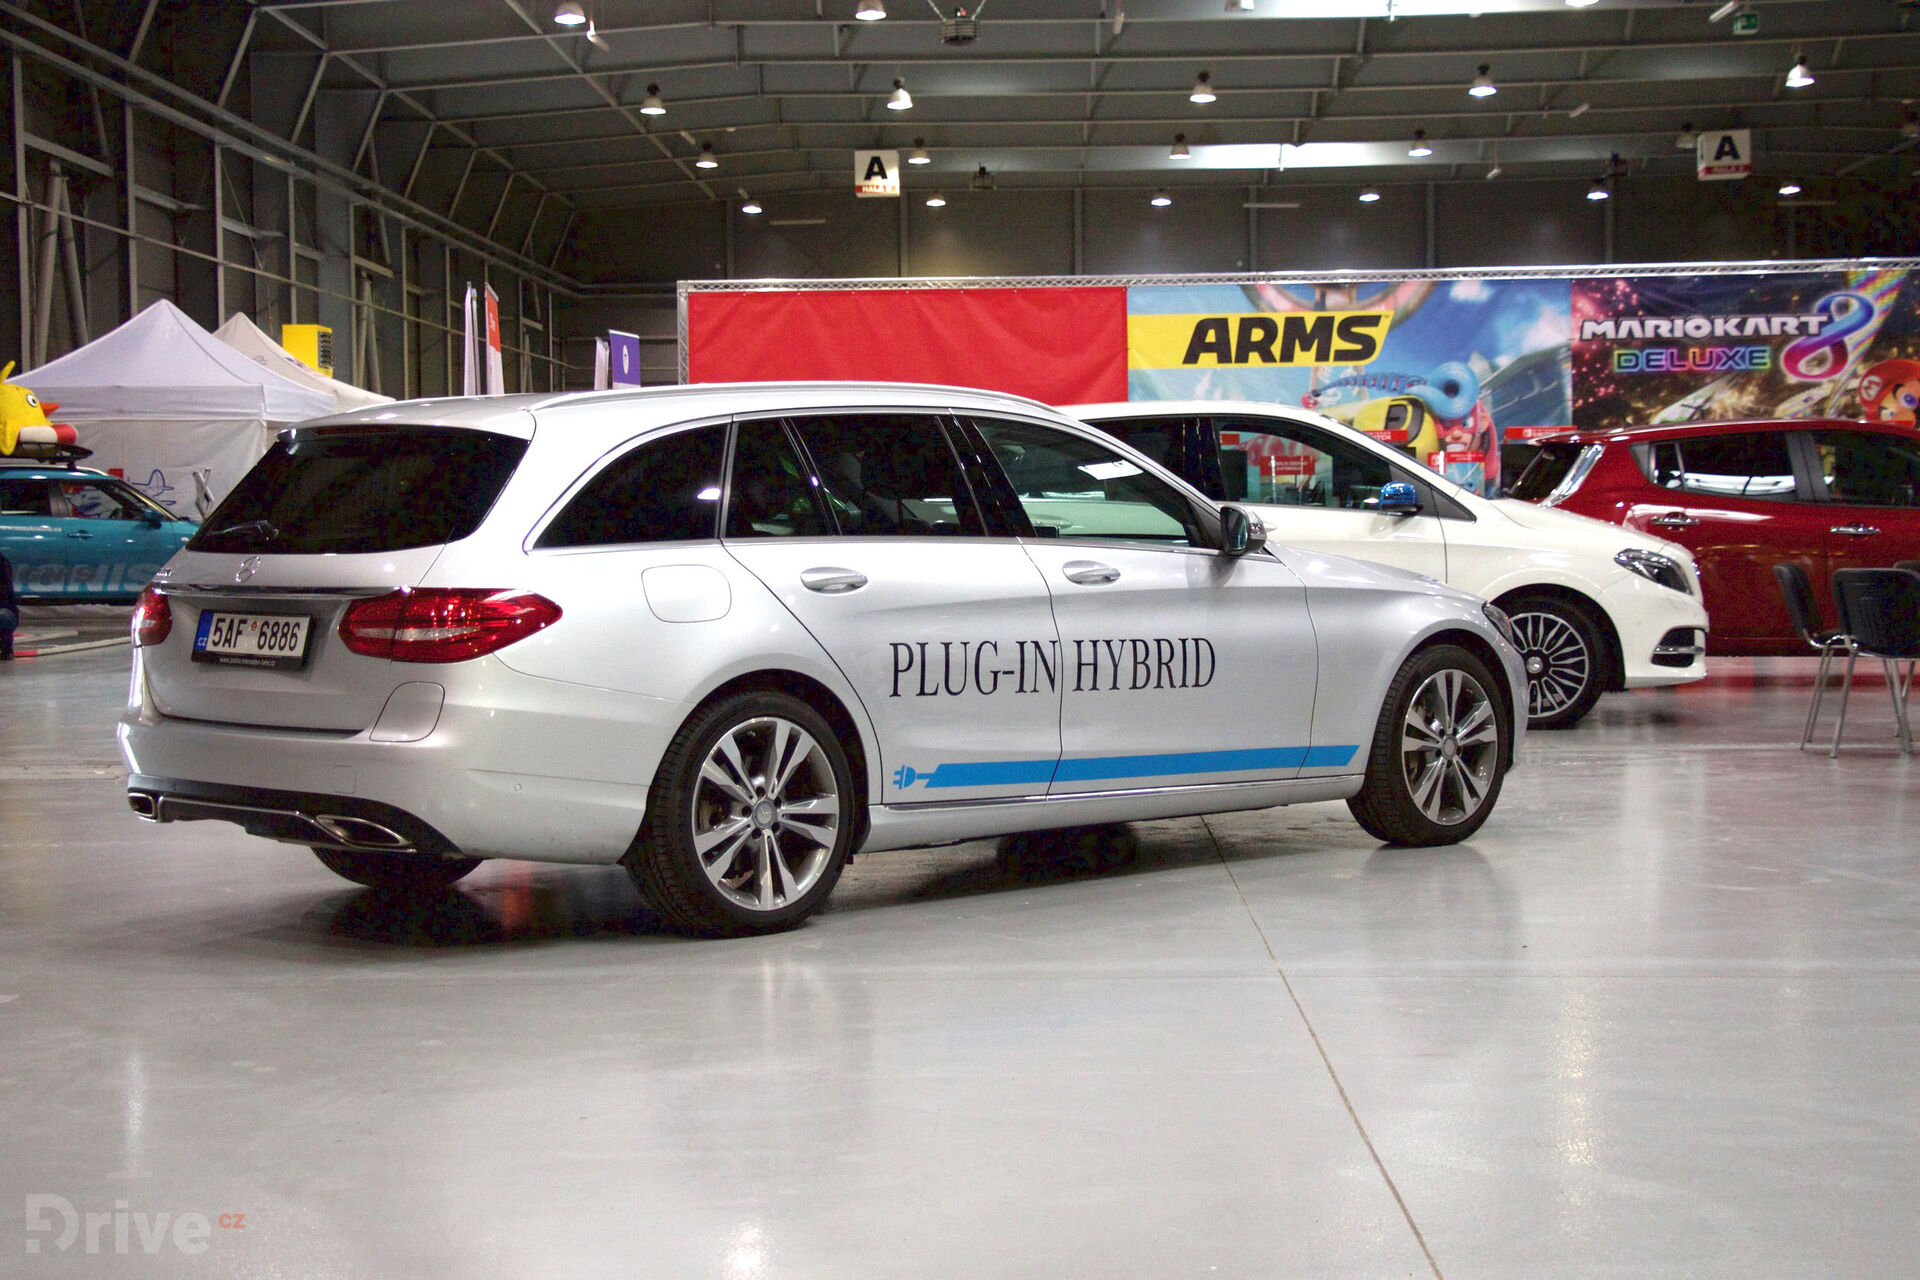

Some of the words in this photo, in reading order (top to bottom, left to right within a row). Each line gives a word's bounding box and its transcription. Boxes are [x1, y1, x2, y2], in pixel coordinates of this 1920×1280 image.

[1714, 135, 1740, 160] A
[864, 156, 888, 181] A
[1182, 314, 1382, 364] ARMS
[1780, 292, 1875, 381] 8
[1613, 346, 1771, 373] DELUXE
[198, 636, 207, 646] CZ
[212, 617, 247, 649] 5AF
[257, 620, 301, 652] 6886
[889, 639, 1058, 698] PLUG-IN
[1072, 637, 1216, 692] HYBRID
